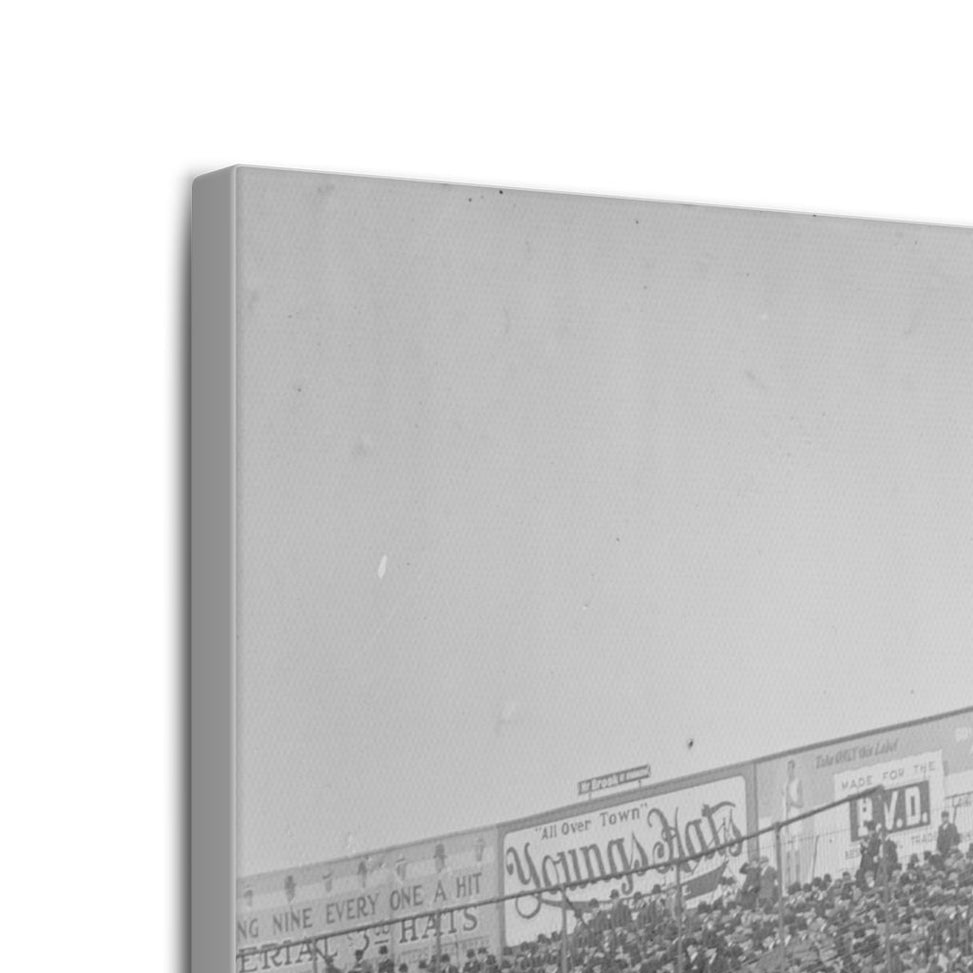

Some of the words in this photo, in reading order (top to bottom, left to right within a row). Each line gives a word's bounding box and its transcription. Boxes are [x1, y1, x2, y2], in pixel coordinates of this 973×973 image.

[841, 775, 874, 790] MADE
[882, 767, 905, 781] FOR
[912, 760, 936, 774] THE
[561, 819, 592, 836] Over
[599, 803, 648, 828] Town"
[647, 800, 744, 875] Hats
[272, 905, 313, 936] NINE
[326, 892, 380, 924] EVERY
[389, 884, 423, 911] ONE
[434, 880, 447, 903] A
[456, 872, 482, 899] HIT
[400, 906, 479, 944] HATS
